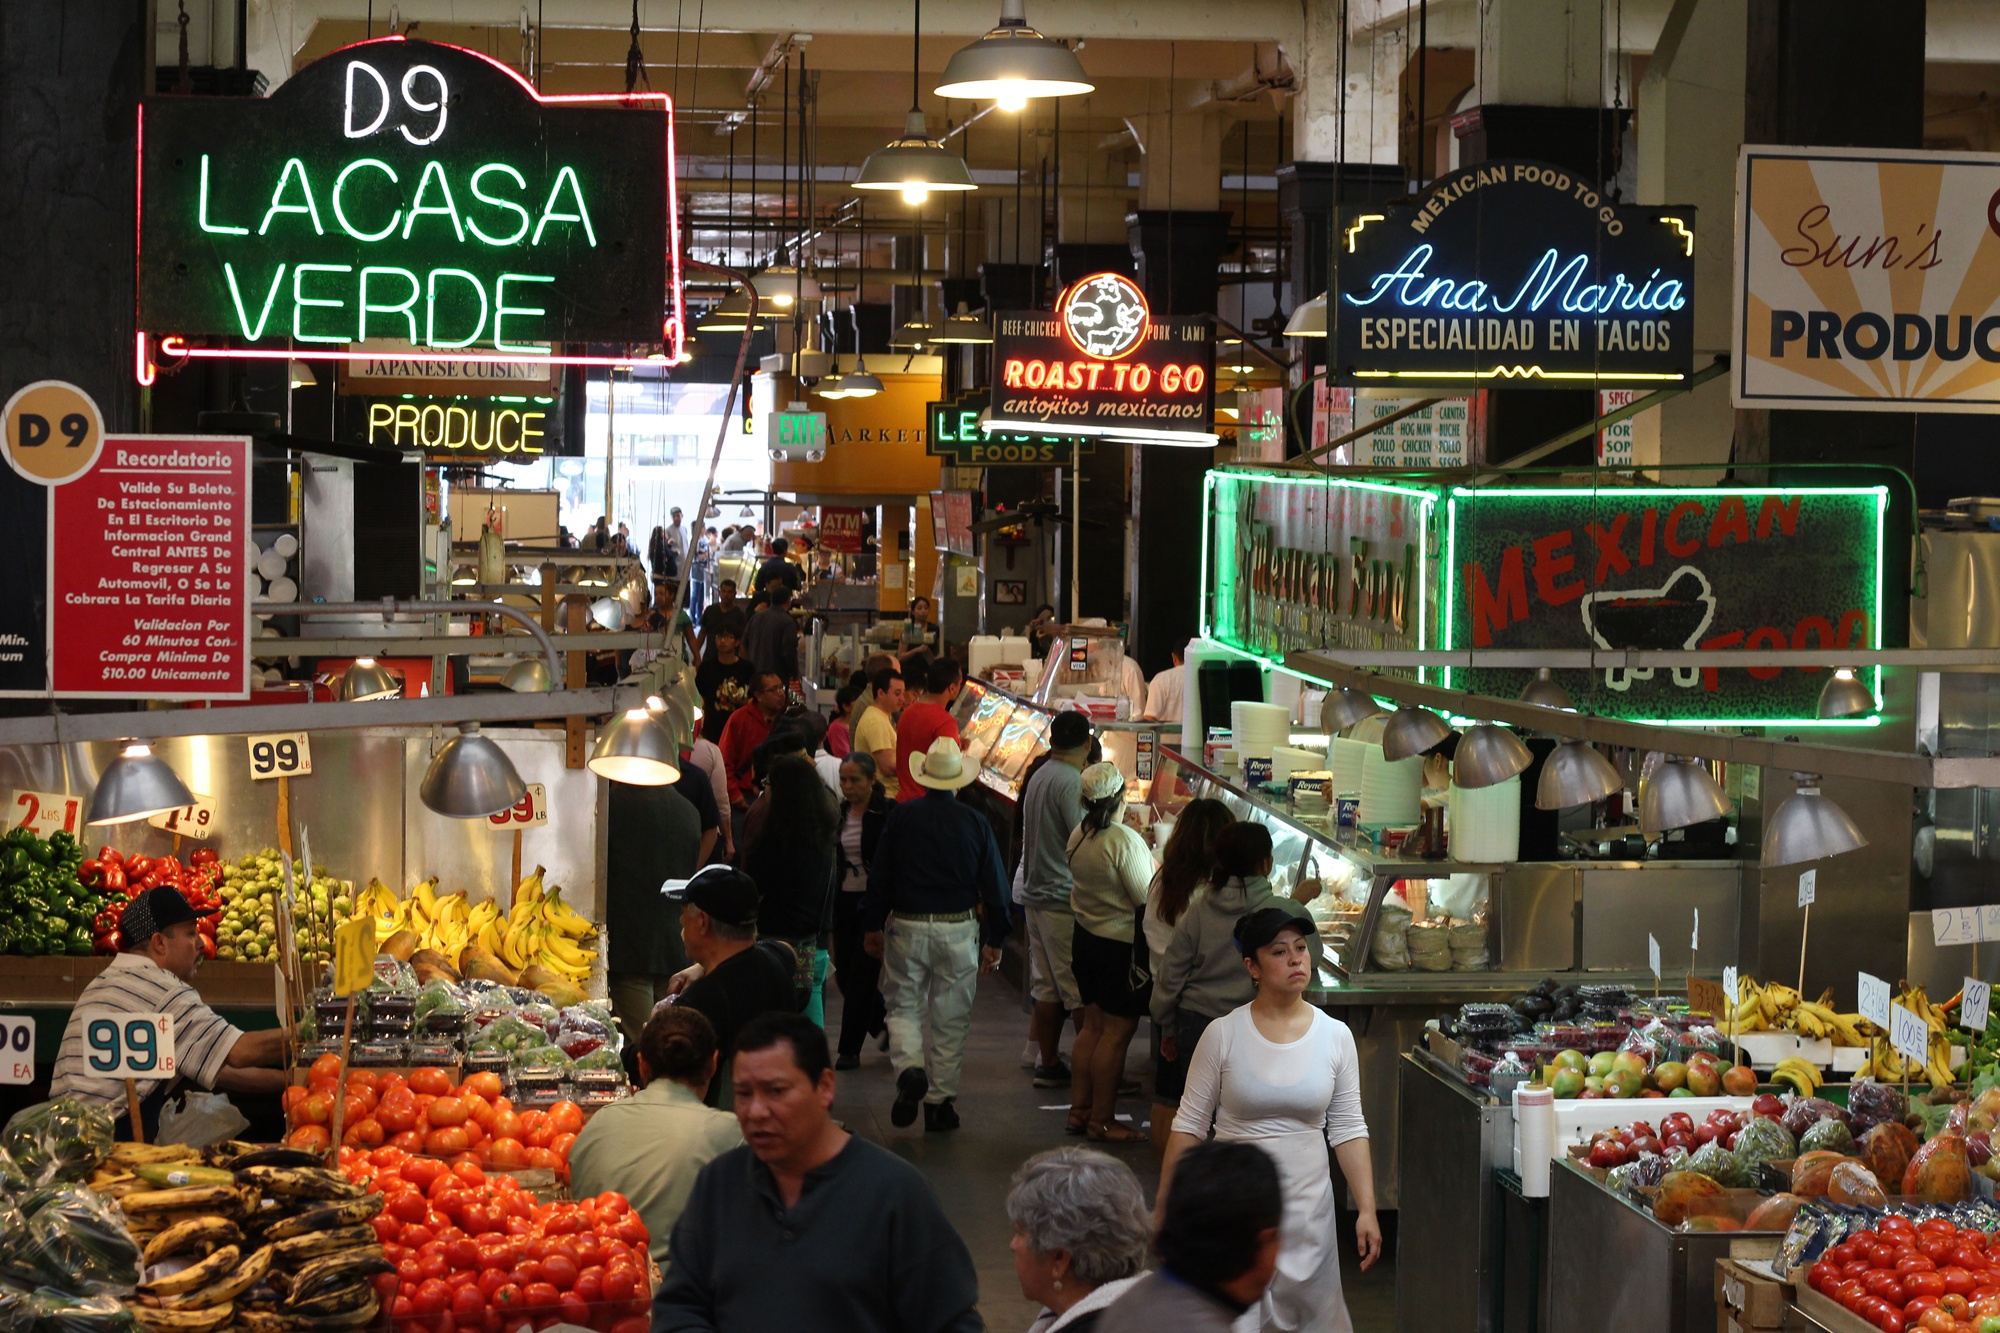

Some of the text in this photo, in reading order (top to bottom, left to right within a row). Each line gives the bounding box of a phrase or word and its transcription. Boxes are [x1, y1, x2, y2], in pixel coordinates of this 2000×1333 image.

[1411, 165, 1624, 237] MEXICAN FOOD TO GO
[1781, 205, 1943, 270] Sun's
[1346, 243, 1489, 313] Ana
[224, 262, 556, 354] VERDE
[1147, 324, 1206, 342] PORK LAMB
[1361, 318, 1671, 351] ESPECIALIDAD EN TACOS
[365, 360, 538, 379] JAPANESE CUISINE
[1003, 359, 1205, 394] ROAST TO GO
[1002, 395, 1203, 421] antojitos mexicanos
[1439, 406, 1466, 420] CARNITAS
[369, 403, 546, 453] PRODUCE
[779, 415, 817, 445] EXIT
[1439, 424, 1461, 437] BUCHE
[1373, 439, 1396, 452] POLLO
[1401, 440, 1432, 453] CHICKEN
[1439, 440, 1461, 453] POLLO
[116, 451, 232, 467] Recordatorio
[971, 444, 1054, 462] FOODS
[119, 482, 232, 495] Valide Su Boleto
[97, 498, 232, 511] De Estacionamiento
[108, 514, 232, 527] En El Escritorio De
[823, 513, 860, 529] ATM
[104, 530, 232, 542] Informacion Grand
[111, 546, 231, 558] Central ANTES De
[132, 562, 232, 576] Regresar A Su
[1464, 495, 1803, 648] MEXICAN
[98, 577, 231, 591] Automovil, O Se Le
[65, 593, 231, 606] Cobrara La Tarifa Diaria
[134, 619, 230, 631] Validacion Por
[122, 635, 231, 647] 60 Minutos Con
[99, 651, 231, 664] Compra Minima De
[102, 667, 230, 681] $10.00 Unicamente
[17, 792, 78, 834] 2 LBS 1
[1938, 910, 1959, 942] 2
[14, 1063, 32, 1078] EA
[159, 1057, 174, 1070] LB
